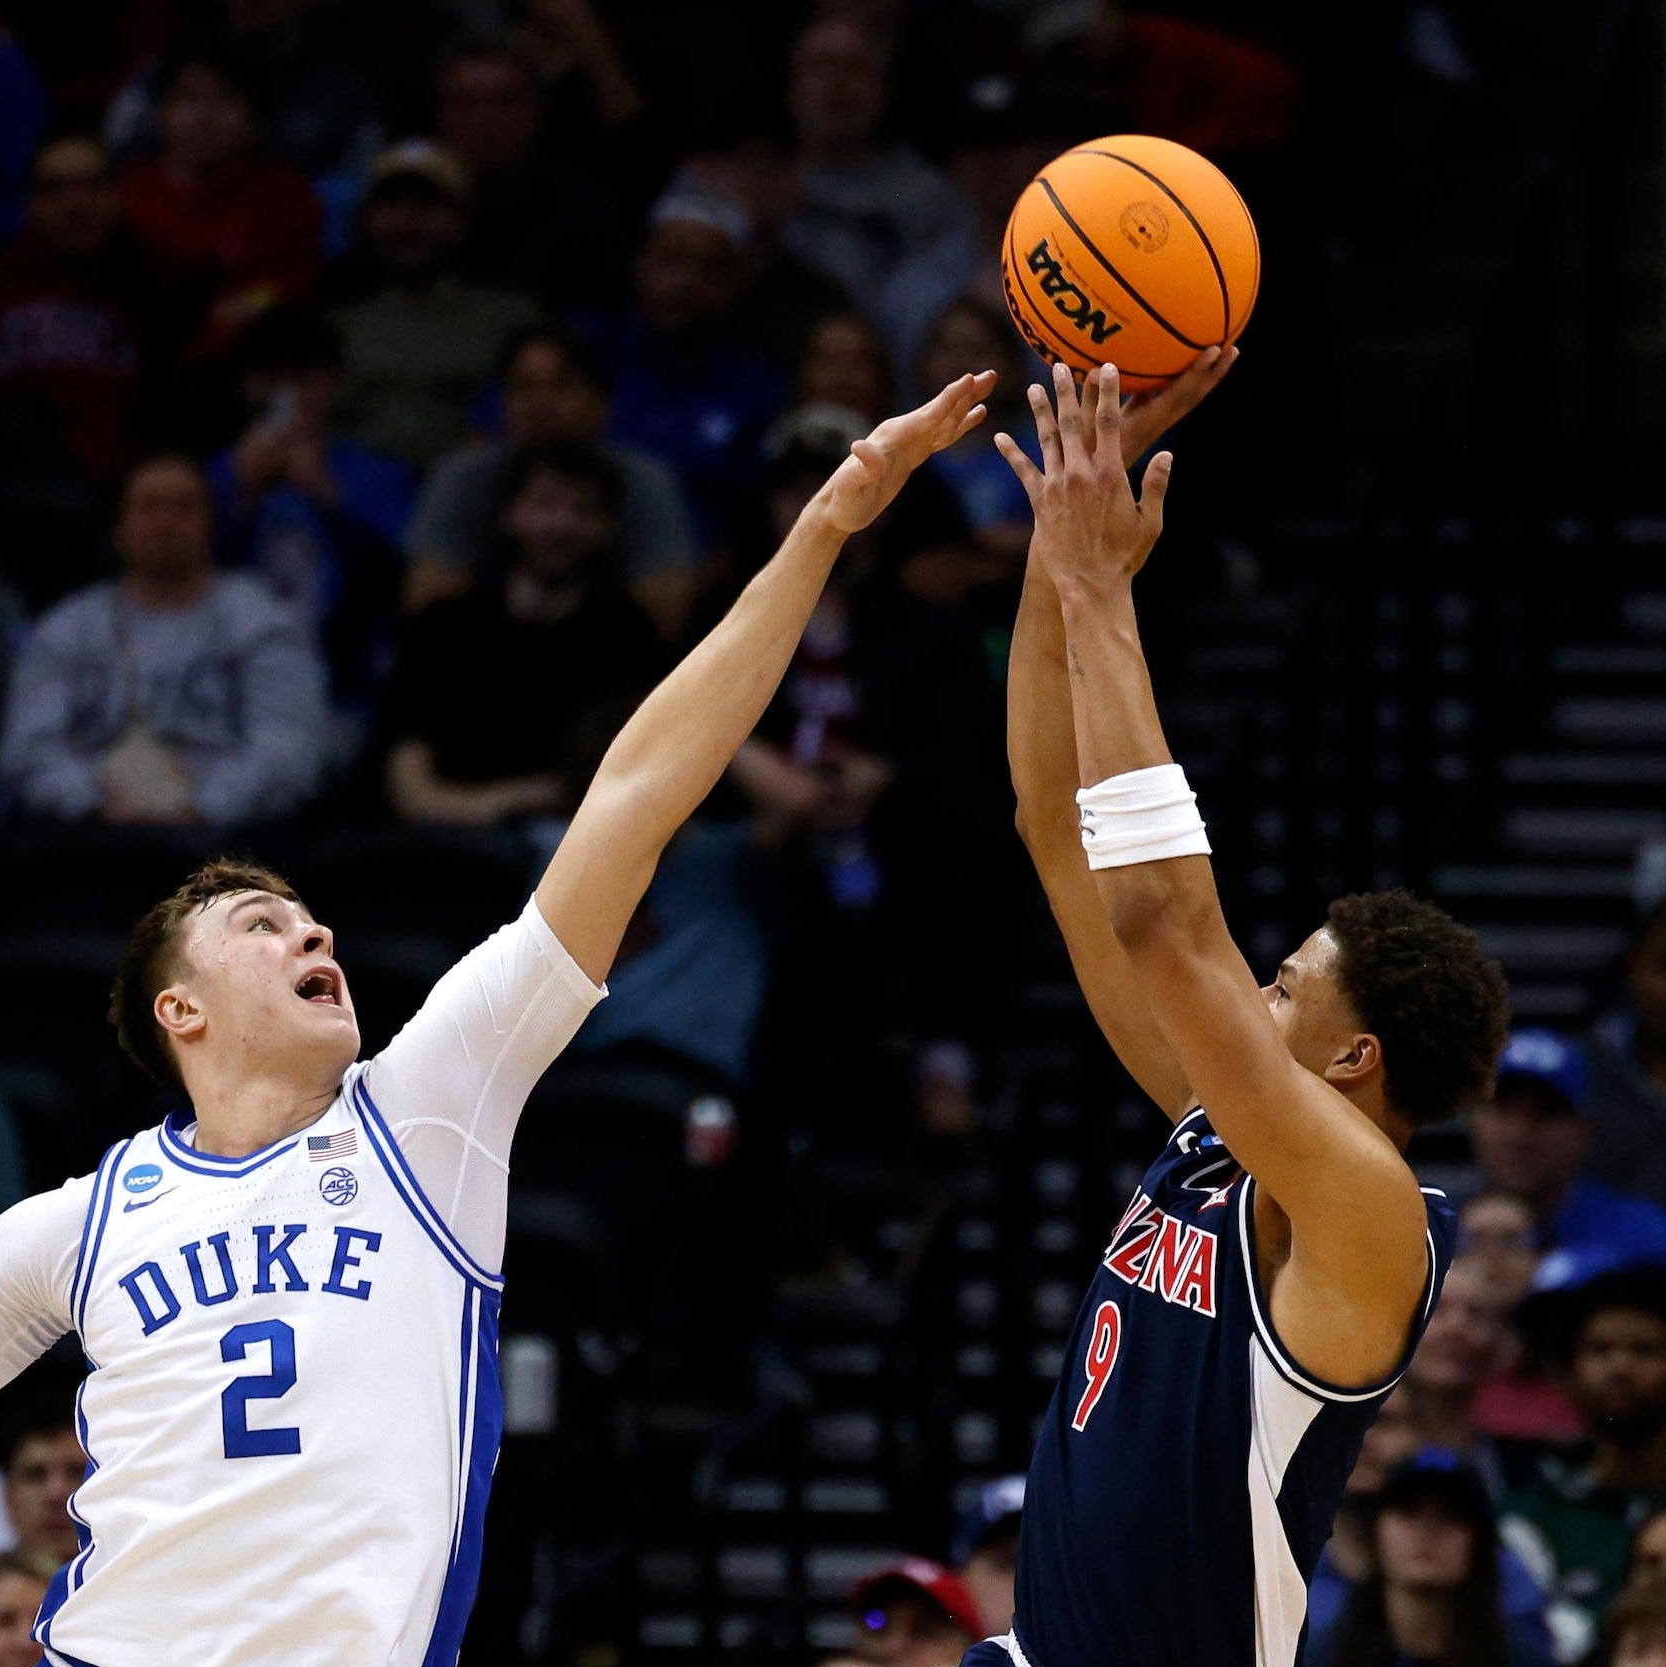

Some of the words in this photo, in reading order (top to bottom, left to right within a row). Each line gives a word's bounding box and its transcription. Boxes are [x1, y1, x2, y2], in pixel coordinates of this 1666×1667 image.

[1026, 237, 1123, 345] NCAA
[126, 1174, 161, 1187] NCAA
[324, 1178, 357, 1192] ACC
[118, 1223, 383, 1338] DUKE
[219, 1318, 302, 1460] 2
[1070, 1299, 1124, 1433] 9
